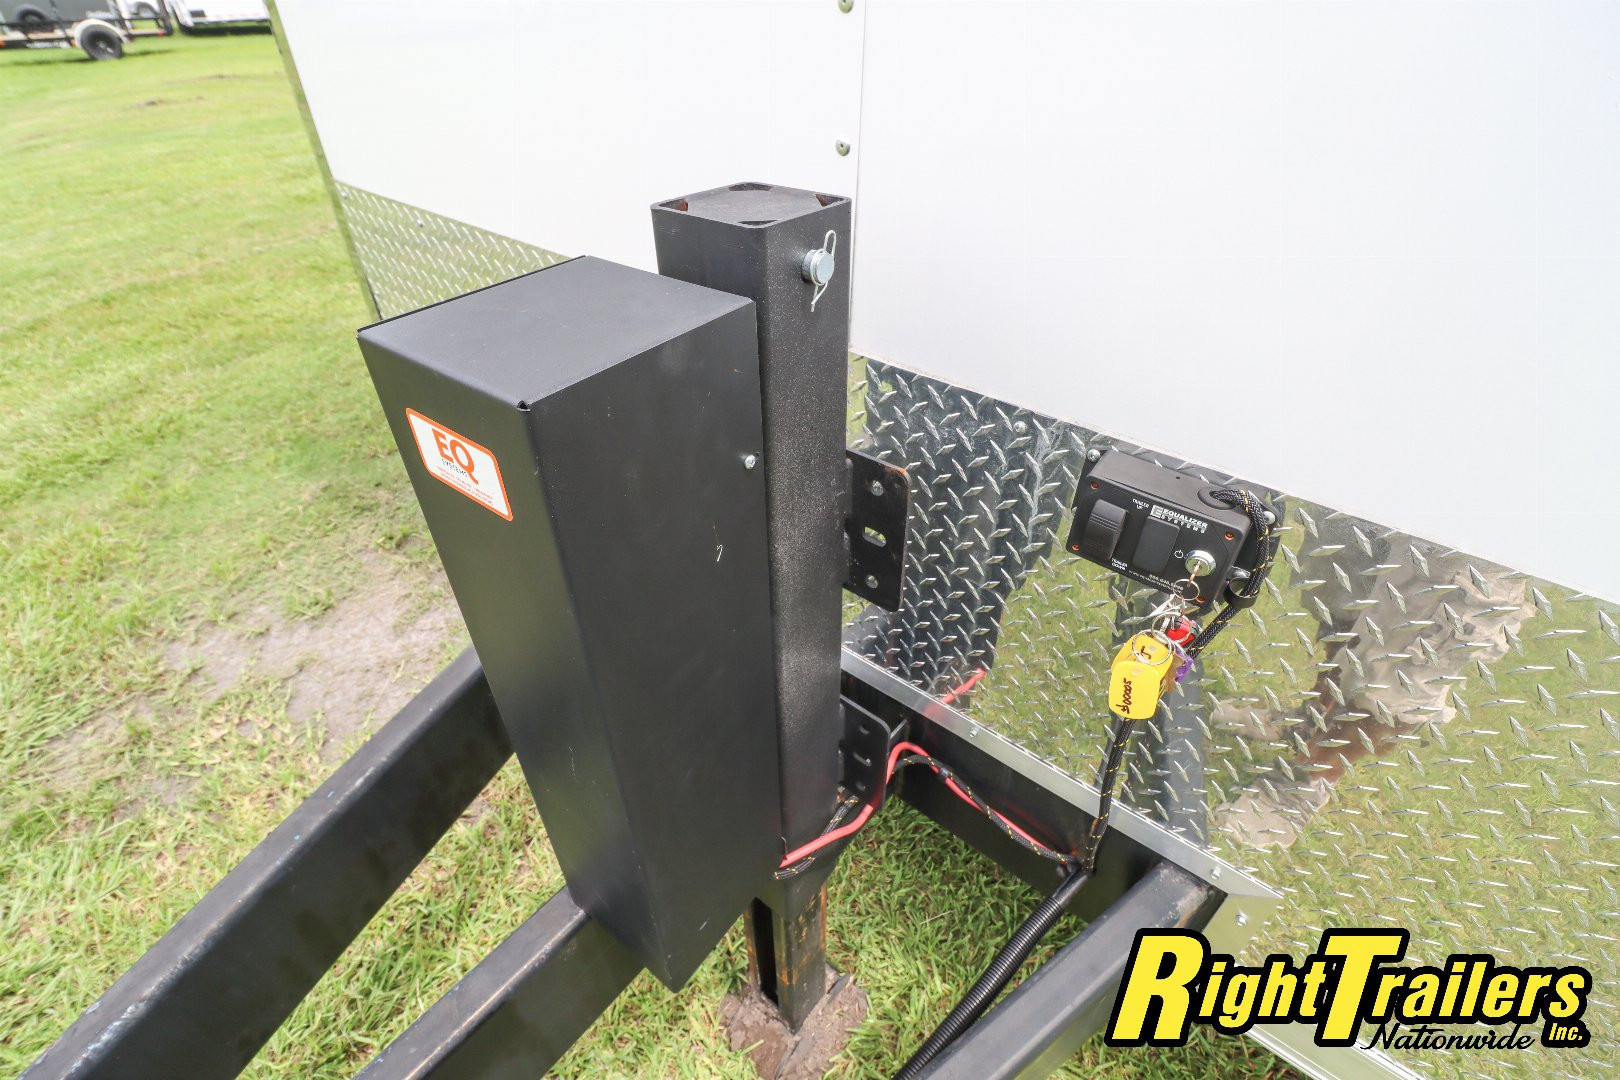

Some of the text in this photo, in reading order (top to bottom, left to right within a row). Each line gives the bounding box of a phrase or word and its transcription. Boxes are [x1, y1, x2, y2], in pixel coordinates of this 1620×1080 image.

[432, 429, 479, 485] EQ
[1162, 508, 1207, 529] EQUALIZER
[1162, 514, 1206, 533] SYSTEMS
